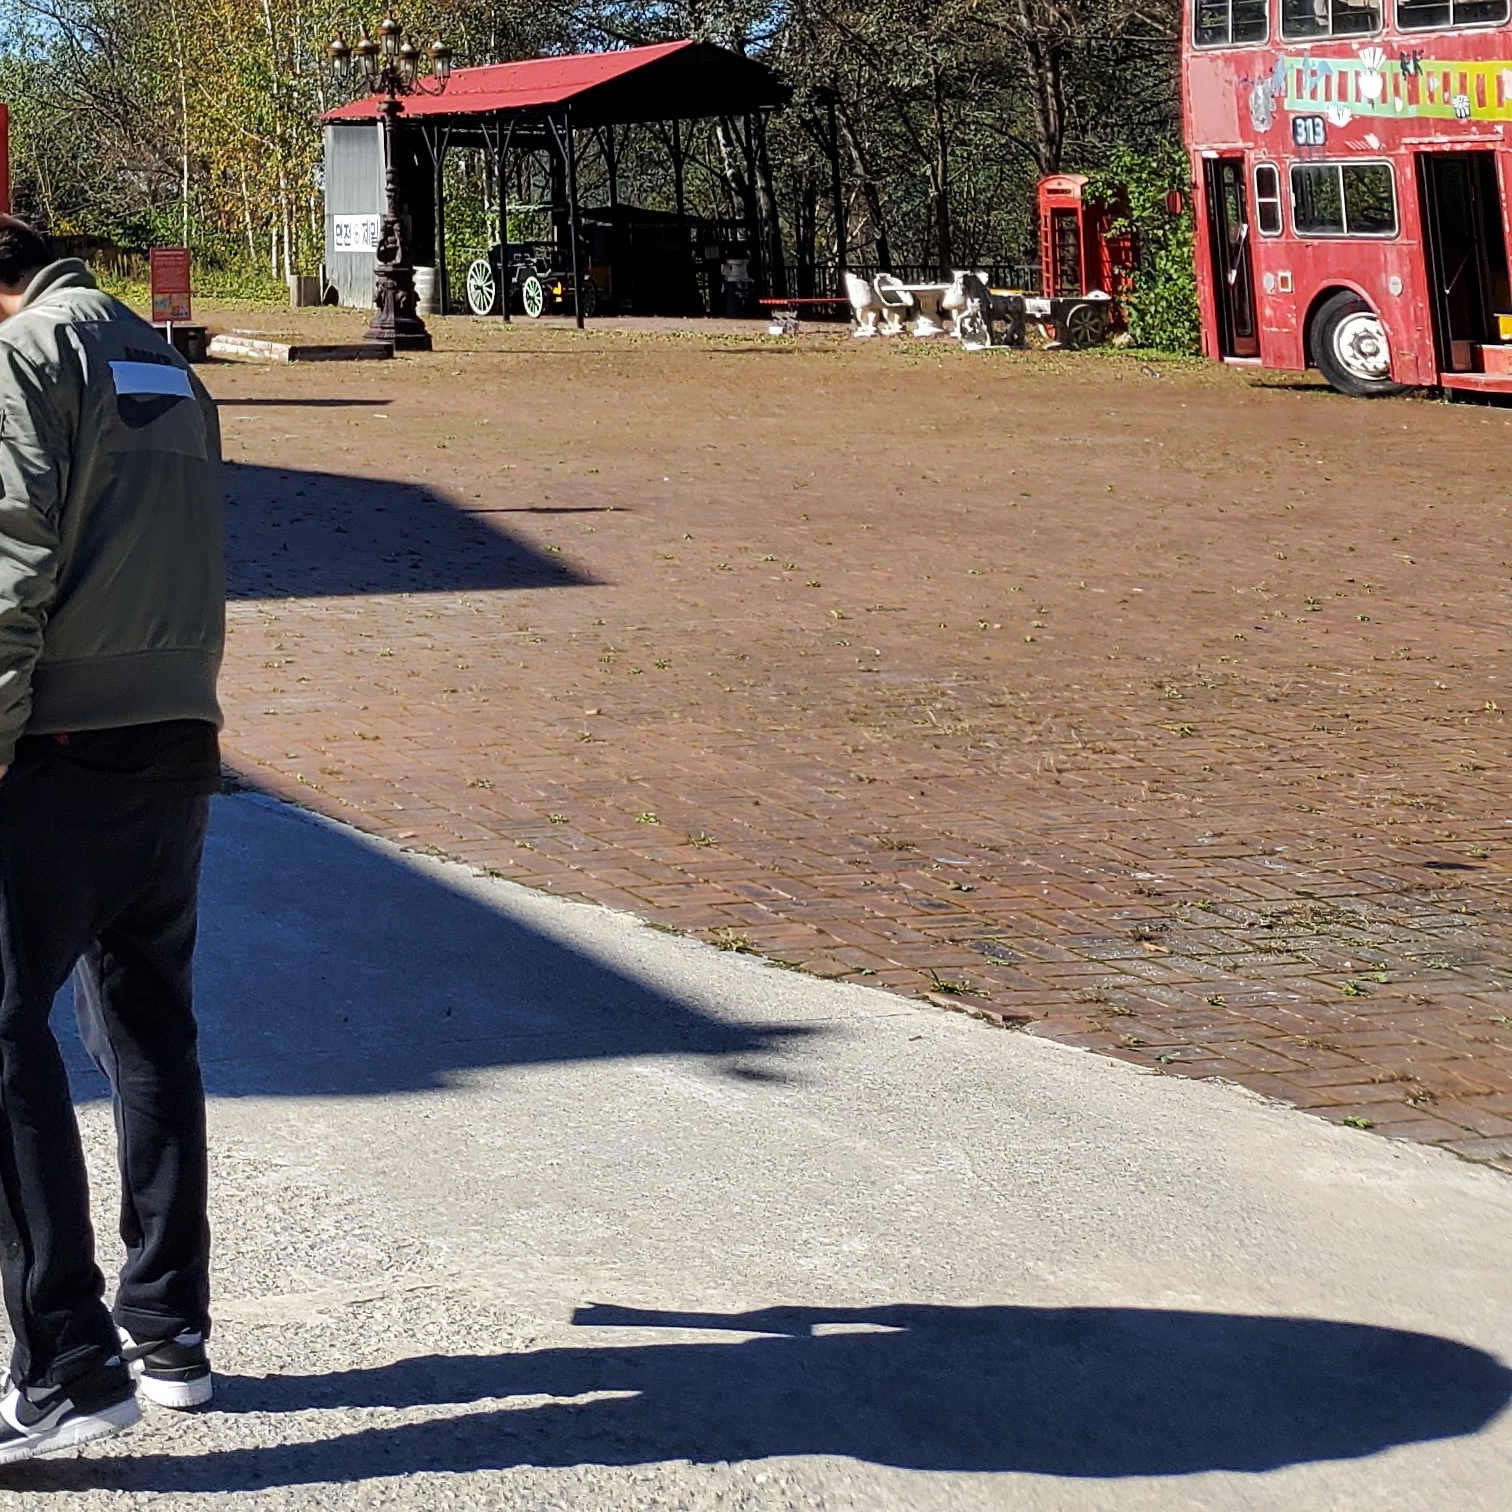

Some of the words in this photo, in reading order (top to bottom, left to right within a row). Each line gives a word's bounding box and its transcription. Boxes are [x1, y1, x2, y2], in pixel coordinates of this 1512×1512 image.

[1295, 117, 1325, 145] 313
[335, 222, 351, 247] 안전
[361, 219, 379, 248] 제일
